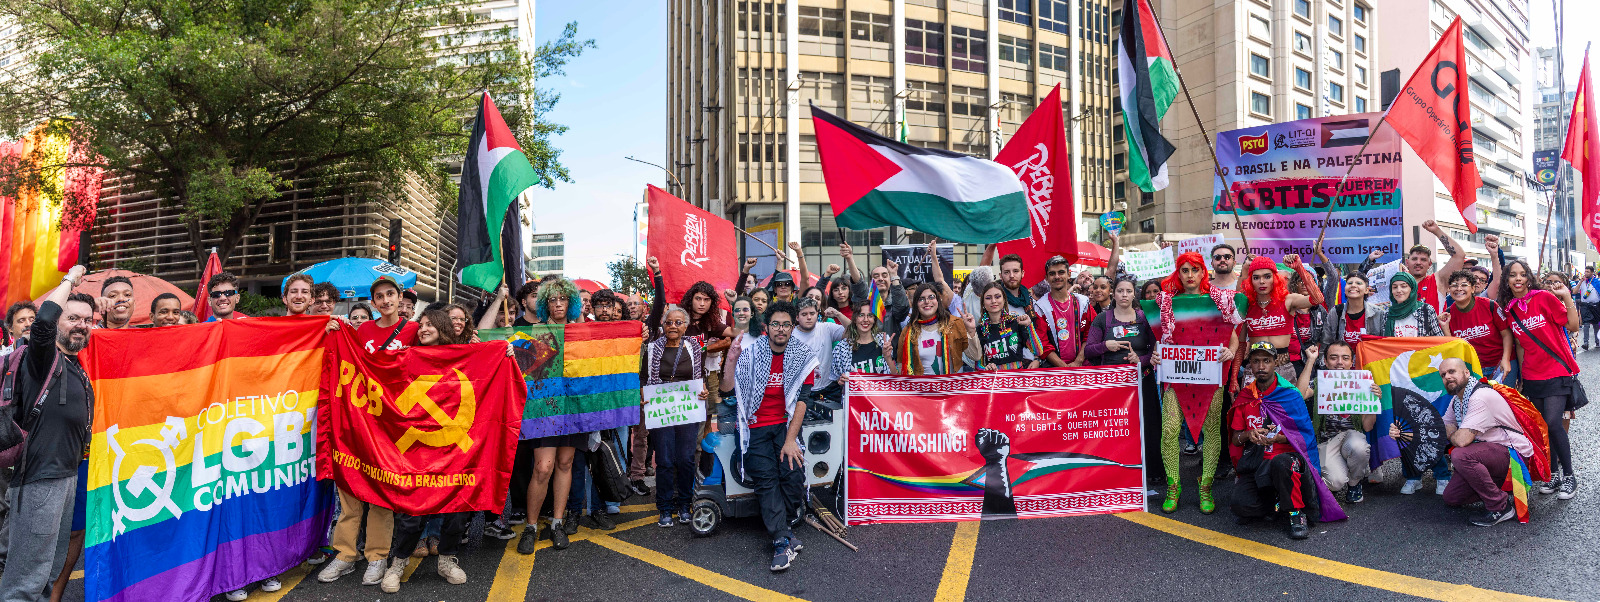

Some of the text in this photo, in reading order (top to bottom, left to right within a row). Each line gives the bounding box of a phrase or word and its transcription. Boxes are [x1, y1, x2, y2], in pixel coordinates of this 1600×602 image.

[1406, 86, 1427, 109] Grupo
[1426, 106, 1451, 135] Operário
[1288, 128, 1316, 139] LIT-QI
[1242, 138, 1265, 151] PSTU
[1235, 162, 1276, 176] BRASIL
[1280, 160, 1289, 172] E
[1293, 158, 1311, 171] NA
[1317, 151, 1402, 169] PALESTINA
[1335, 178, 1394, 194] QUEREM
[1219, 182, 1331, 212] LGBTIS
[1336, 192, 1393, 208] VIVER
[1212, 216, 1403, 231] SEM GENOCÍDIO E PINKWASHING!
[1236, 246, 1275, 256] rompa
[1327, 246, 1355, 256] com
[1358, 242, 1399, 256] Israel!
[904, 264, 931, 274] A CLT
[1174, 360, 1202, 374] NOW!
[335, 359, 384, 417] PCB
[197, 389, 299, 430] COLETIVO
[1005, 407, 1129, 423] NO BRASIL E NA PALESTINA
[860, 407, 914, 431] NÃO AO
[1015, 418, 1129, 433] AS LGBTIs QUEREM VIVER
[1062, 427, 1130, 441] SEM GENOCÍDIO
[860, 432, 967, 453] PINKWASHING!
[193, 455, 317, 512] COMUNIST
[415, 473, 476, 488] BRASILEIRO
